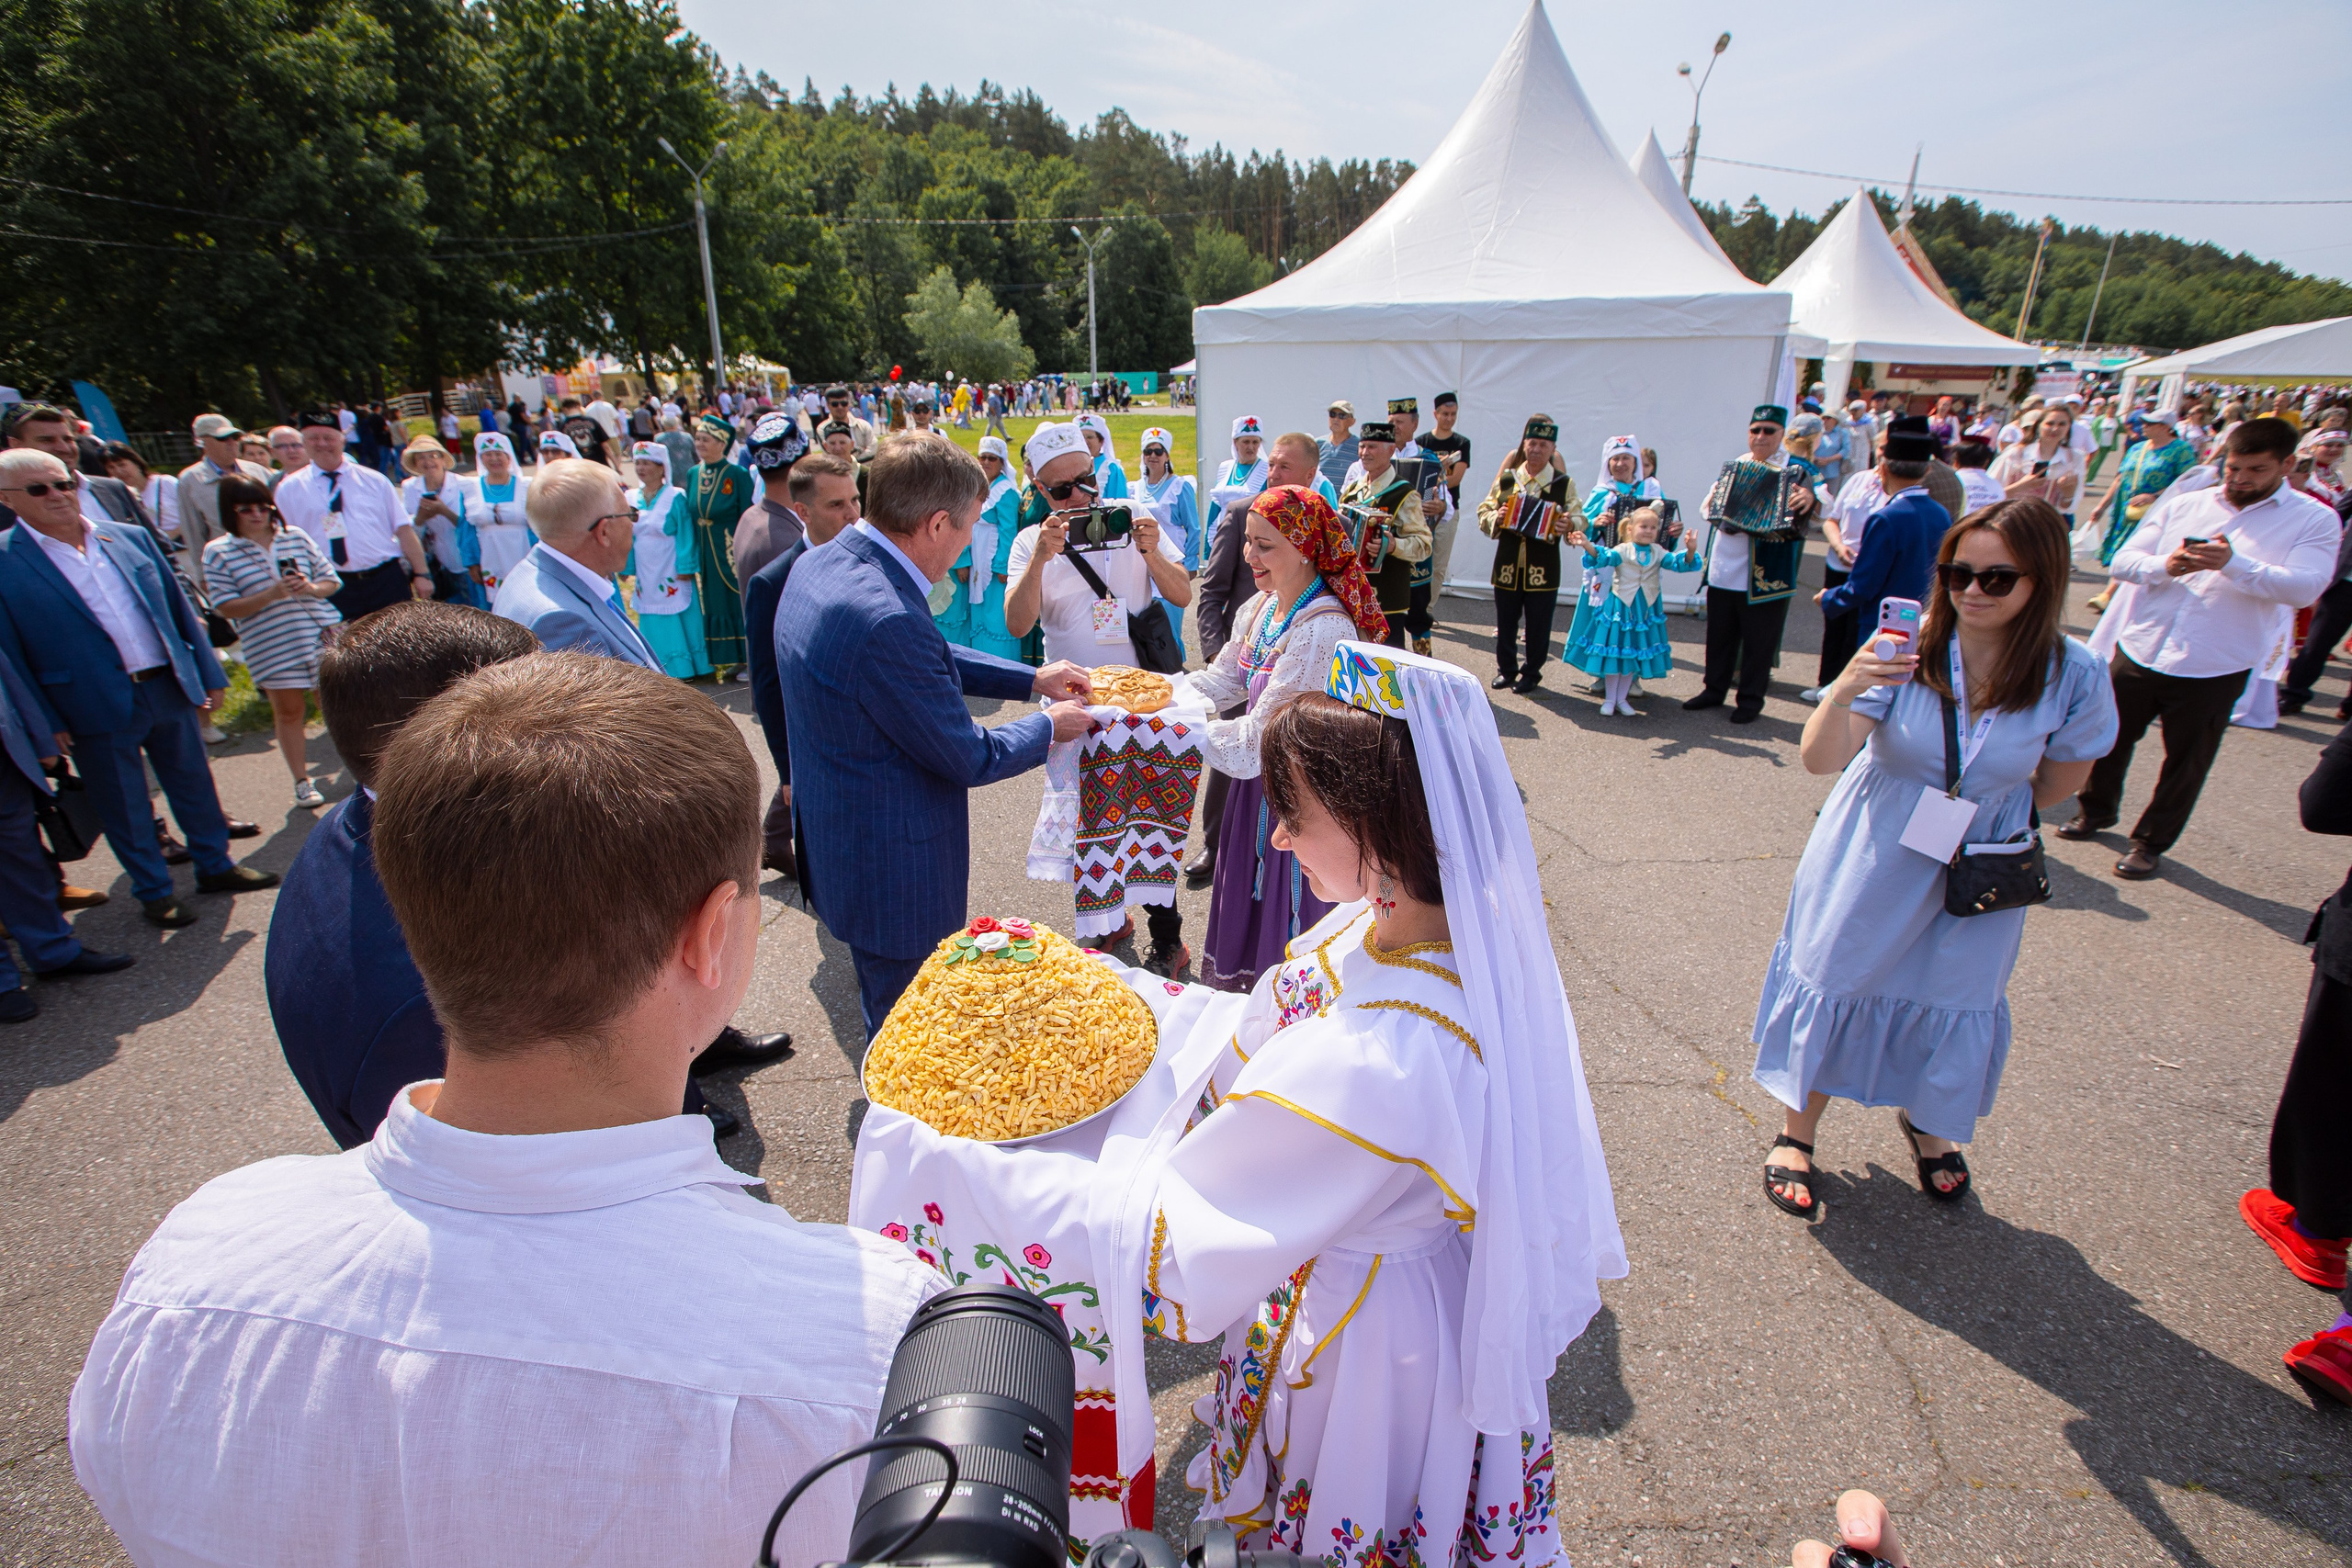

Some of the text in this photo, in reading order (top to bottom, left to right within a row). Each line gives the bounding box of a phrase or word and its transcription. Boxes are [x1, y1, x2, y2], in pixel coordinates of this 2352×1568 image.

[899, 1412, 908, 1421] 70
[918, 1404, 927, 1413] 50
[1029, 1425, 1044, 1438] LOCK
[1023, 1516, 1039, 1532] RXD
